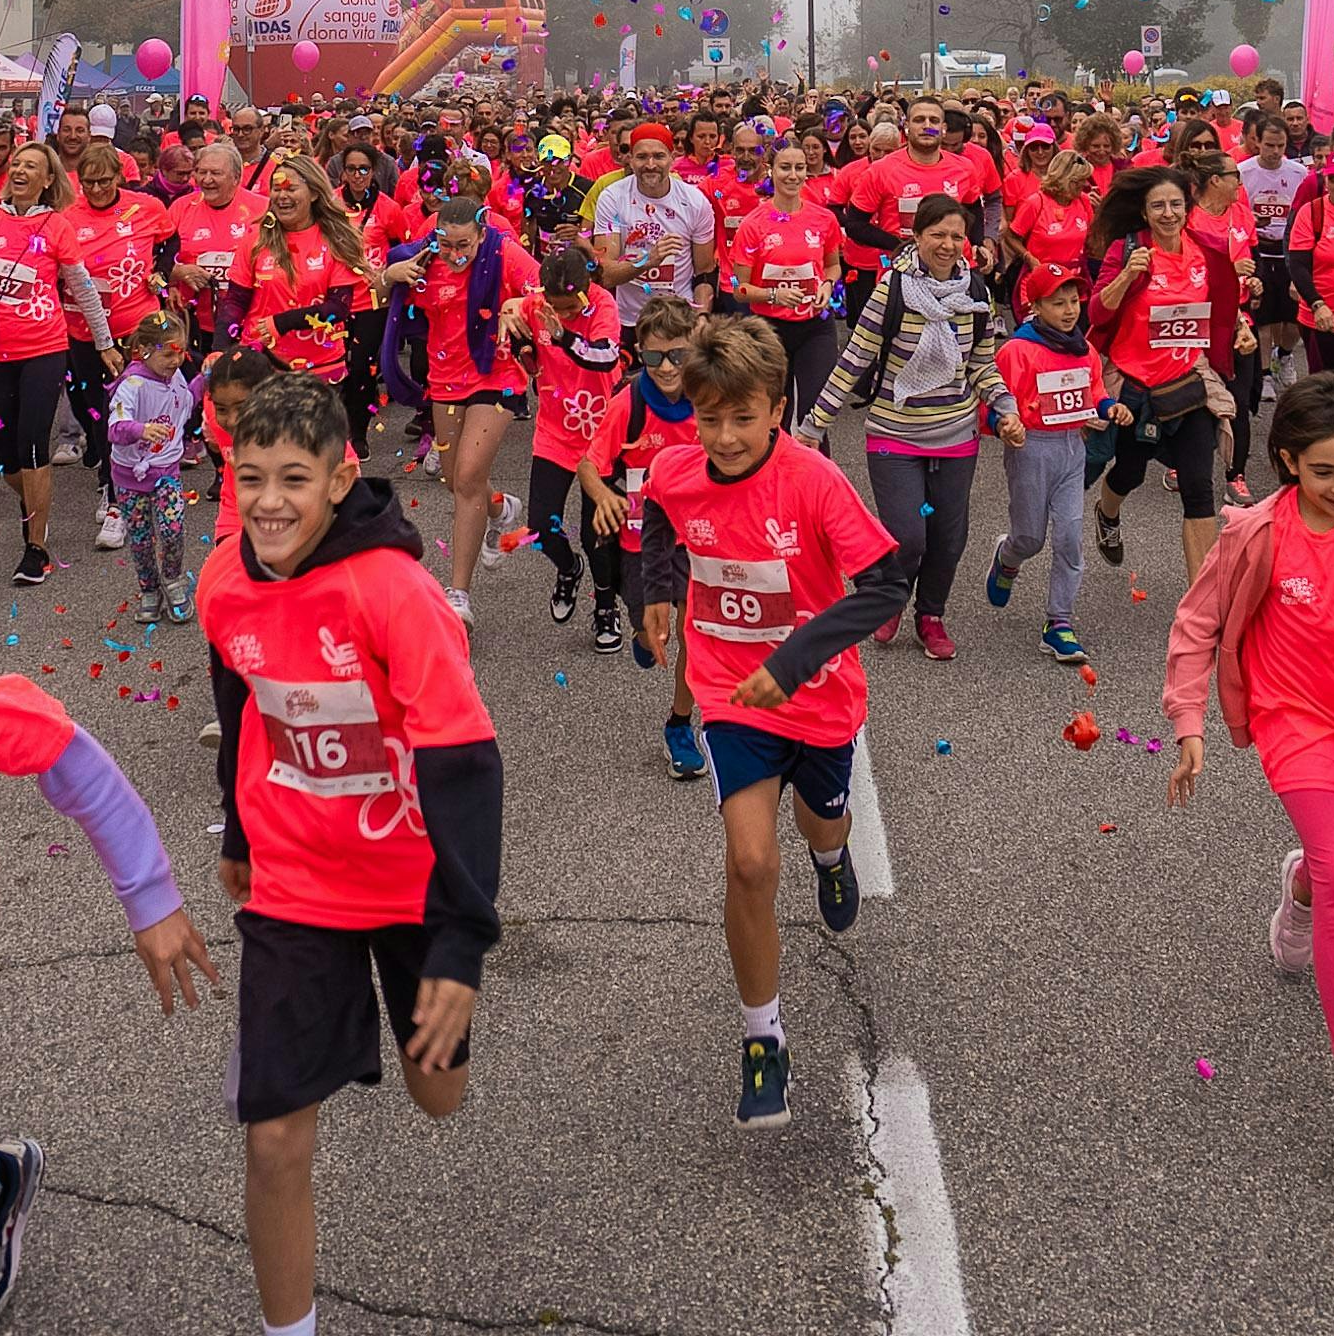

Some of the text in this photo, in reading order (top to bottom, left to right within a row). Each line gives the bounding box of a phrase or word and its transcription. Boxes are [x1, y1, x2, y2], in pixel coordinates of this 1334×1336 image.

[254, 20, 292, 34] IDAS
[324, 10, 376, 28] sangue
[255, 34, 293, 43] ERONA
[307, 22, 348, 41] dona
[352, 24, 376, 40] vita
[1260, 205, 1284, 217] 530
[1159, 320, 1198, 338] 262
[1053, 390, 1084, 412] 193
[720, 591, 762, 624] 69
[284, 728, 348, 770] 116
